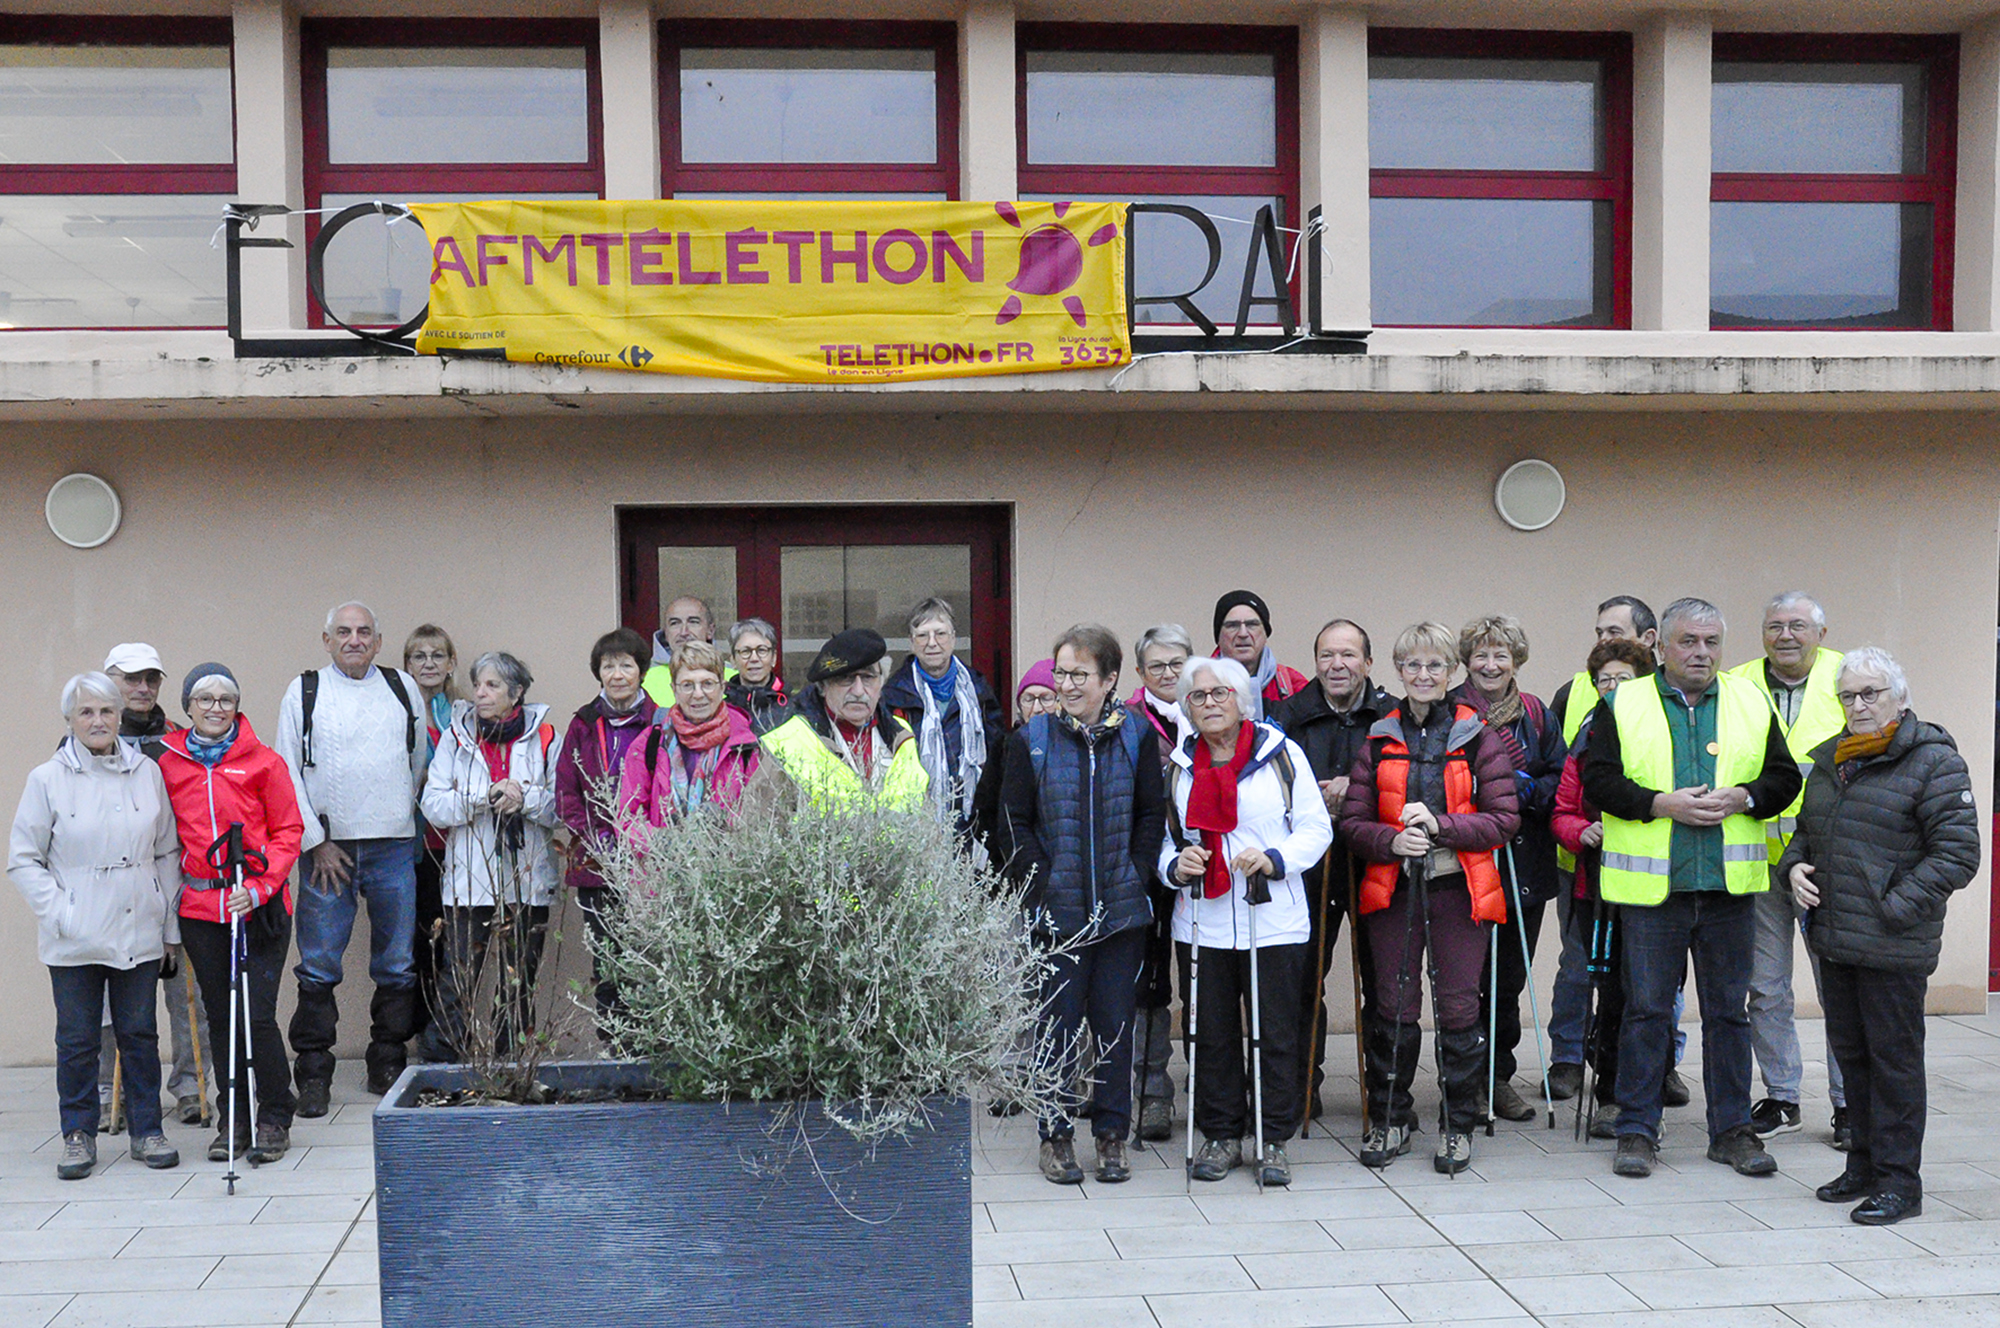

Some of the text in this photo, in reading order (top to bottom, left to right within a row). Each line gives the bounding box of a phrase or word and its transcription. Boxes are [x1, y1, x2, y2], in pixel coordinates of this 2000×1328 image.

[1125, 203, 1373, 340] RAL
[424, 330, 506, 340] AVEC LE SOUTIEN DE
[534, 349, 611, 364] Carrefour
[1059, 343, 1123, 367] 3637
